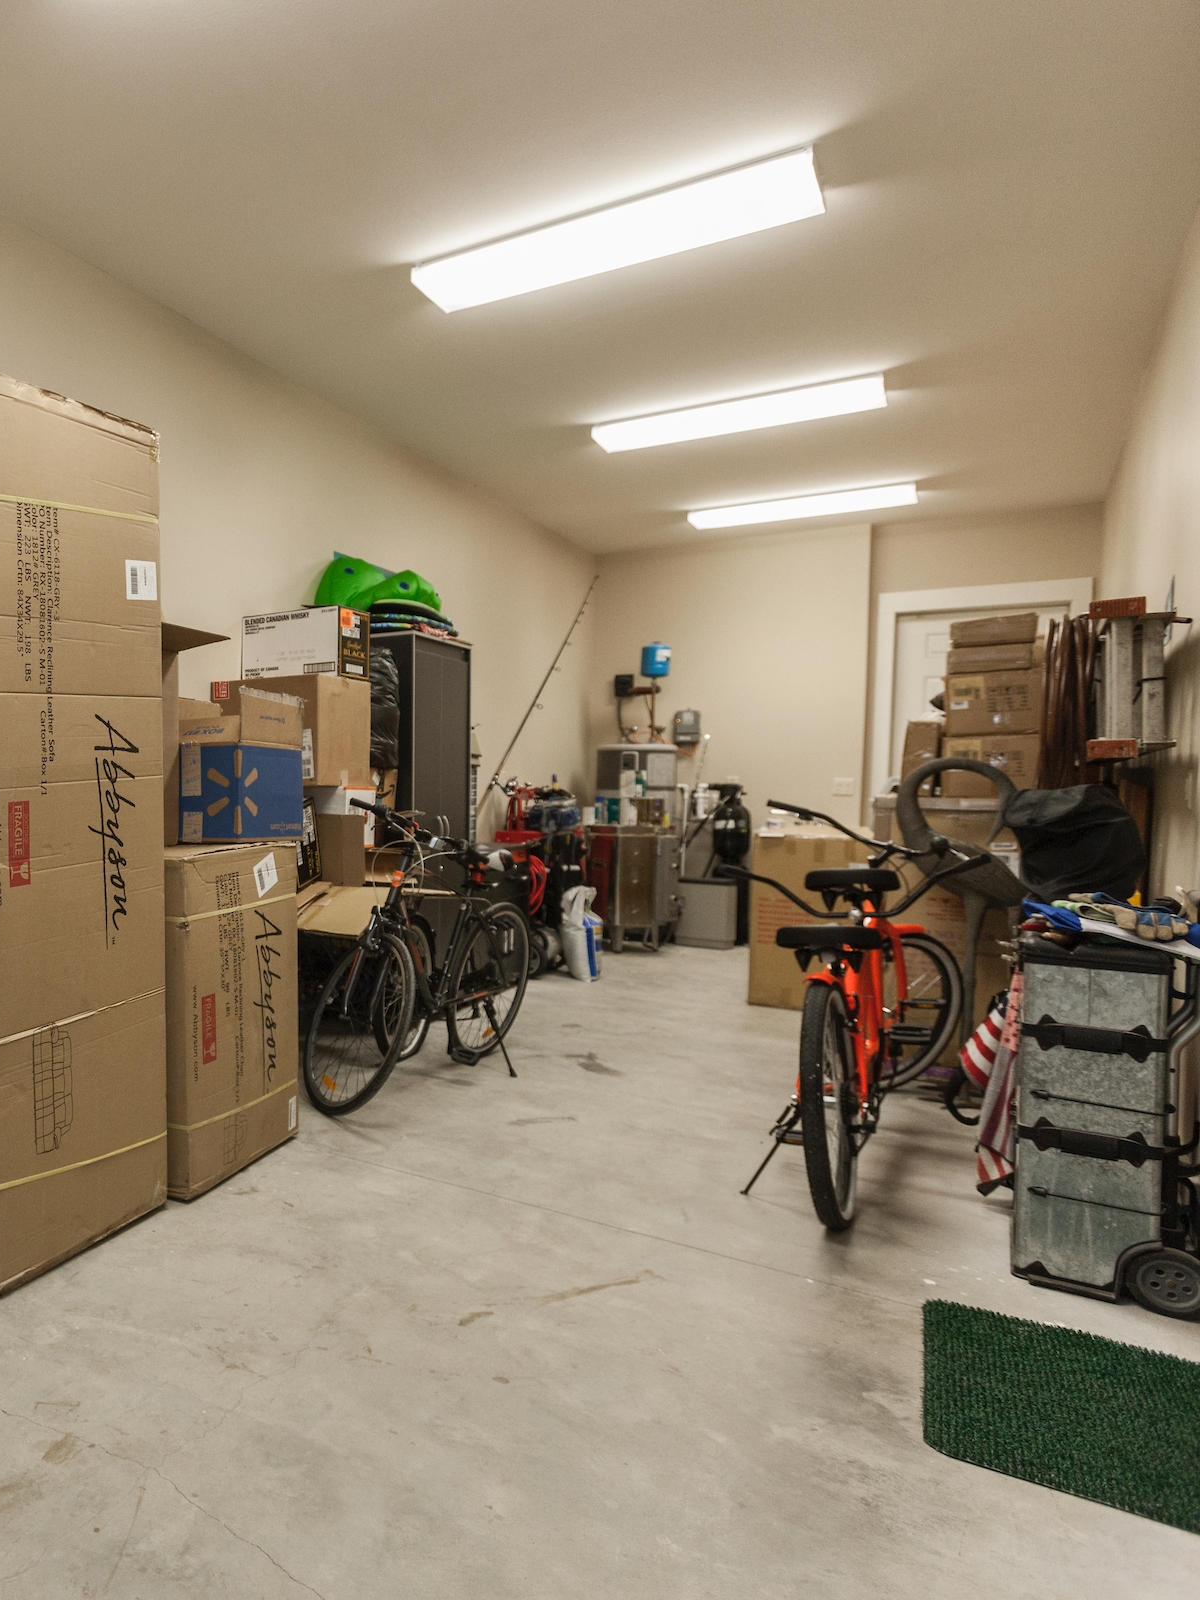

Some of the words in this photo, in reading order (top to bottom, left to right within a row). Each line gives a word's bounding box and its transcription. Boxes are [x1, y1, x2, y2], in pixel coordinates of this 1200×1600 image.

[31, 536, 40, 568] 1812#
[39, 520, 47, 568] Number:
[45, 530, 53, 594] Description:
[32, 572, 40, 601] GREY
[24, 595, 32, 625] NWT:
[46, 598, 54, 642] Clarence
[244, 617, 266, 627] BLENDED
[265, 614, 290, 624] CANADIAN
[290, 611, 310, 621] WHISKY
[24, 635, 32, 654] 198
[46, 646, 54, 694] Reclining
[47, 697, 55, 735] Leather
[48, 739, 56, 763] Sofa
[14, 805, 23, 857] FRAGILE
[88, 714, 140, 930] Abbyson
[253, 910, 283, 1083] Abbyson
